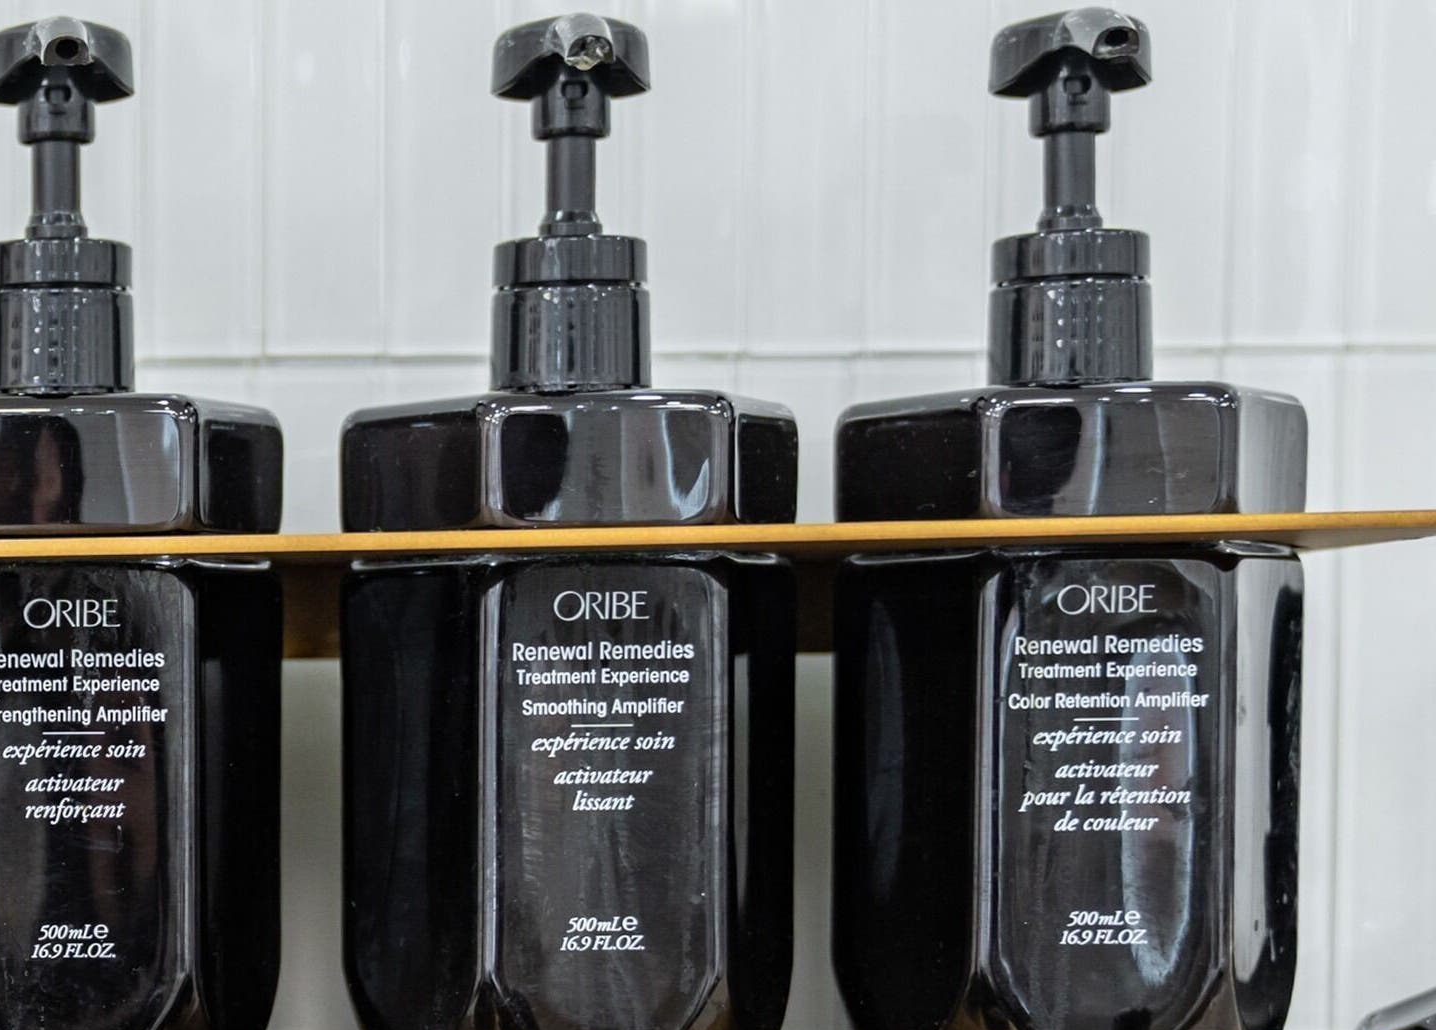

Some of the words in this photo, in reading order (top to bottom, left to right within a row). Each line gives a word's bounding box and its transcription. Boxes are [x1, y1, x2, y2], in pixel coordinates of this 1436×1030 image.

[553, 590, 650, 621] ORIBE
[1057, 584, 1158, 615] ORIBE
[23, 598, 121, 629] ORIBE
[512, 641, 593, 662] Renewal
[599, 640, 695, 660] Remedies
[1014, 636, 1098, 656] Renewal
[1105, 634, 1204, 654] Remedies
[71, 648, 165, 669] Remedies
[516, 669, 596, 686] Treatment
[601, 668, 690, 687] Experience
[1018, 663, 1102, 679] Treatment
[1106, 661, 1198, 681] Experience
[73, 676, 160, 695] Experience
[522, 698, 607, 717] Smoothing
[612, 697, 684, 717] Amplifier
[1008, 693, 1050, 710] Color
[1055, 692, 1130, 709] Retention
[1134, 691, 1209, 711] Amplifier
[96, 706, 168, 725] Amplifier
[531, 732, 631, 758] expérience
[634, 731, 675, 750] soin
[1032, 725, 1136, 751] expérience
[1139, 725, 1182, 744] soin
[2, 739, 101, 765] expérience
[105, 739, 146, 759] soin
[553, 766, 653, 785] activateur
[1054, 759, 1159, 778] activateur
[25, 773, 125, 792] activateur
[572, 790, 635, 811] lissant
[1018, 790, 1071, 812] pour
[1074, 784, 1093, 805] la
[1099, 785, 1192, 805] rétention
[25, 797, 126, 825] renforçant
[1054, 811, 1078, 832] de
[1083, 811, 1159, 832] couleur
[31, 943, 63, 959] 16.9
